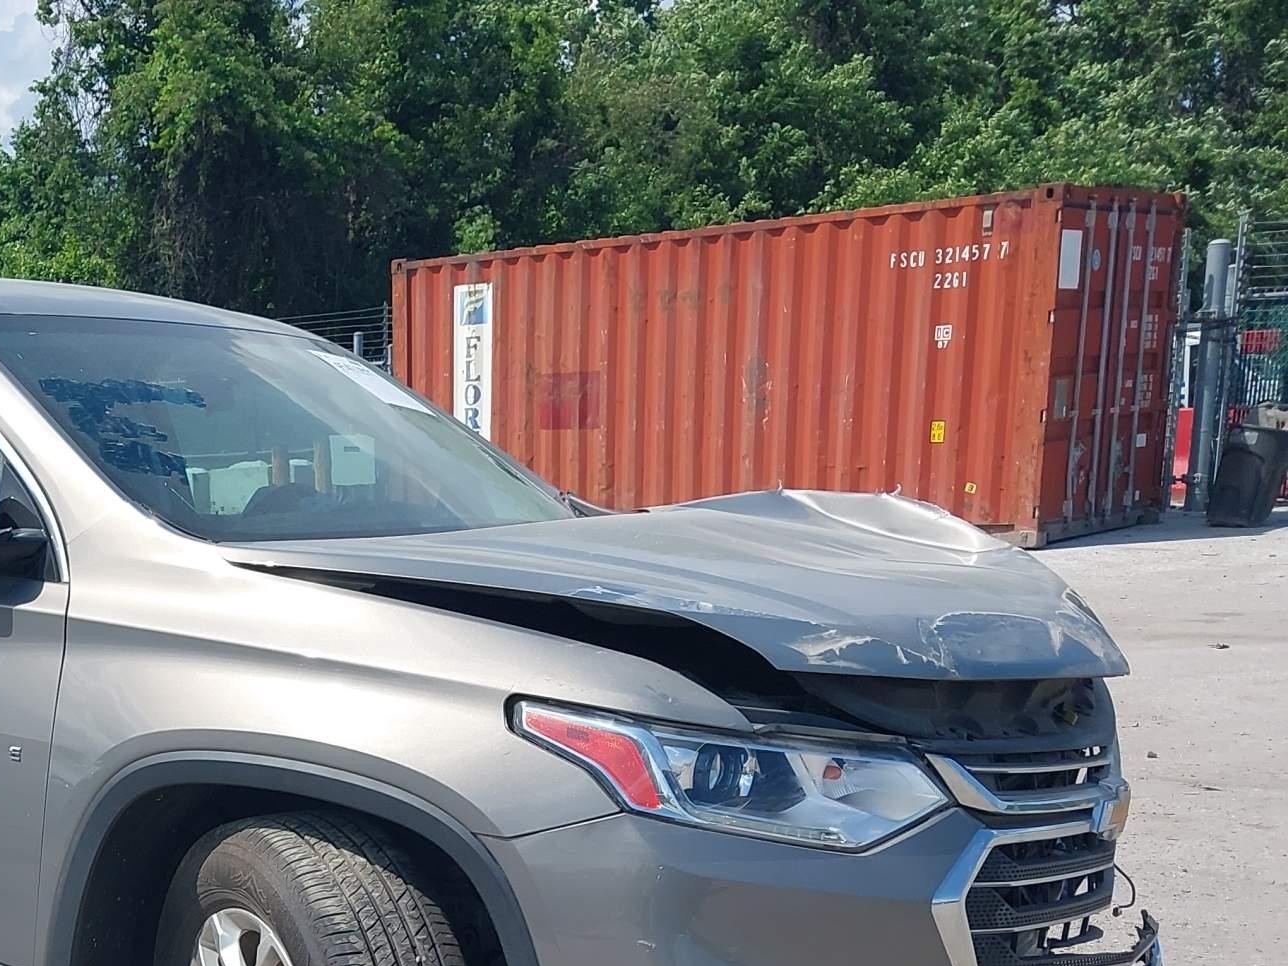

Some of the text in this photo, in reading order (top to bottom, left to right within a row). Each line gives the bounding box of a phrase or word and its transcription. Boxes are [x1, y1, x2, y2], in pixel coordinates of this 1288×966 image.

[889, 240, 1009, 269] FSCU 321457 7
[464, 336, 482, 433] FLOR
